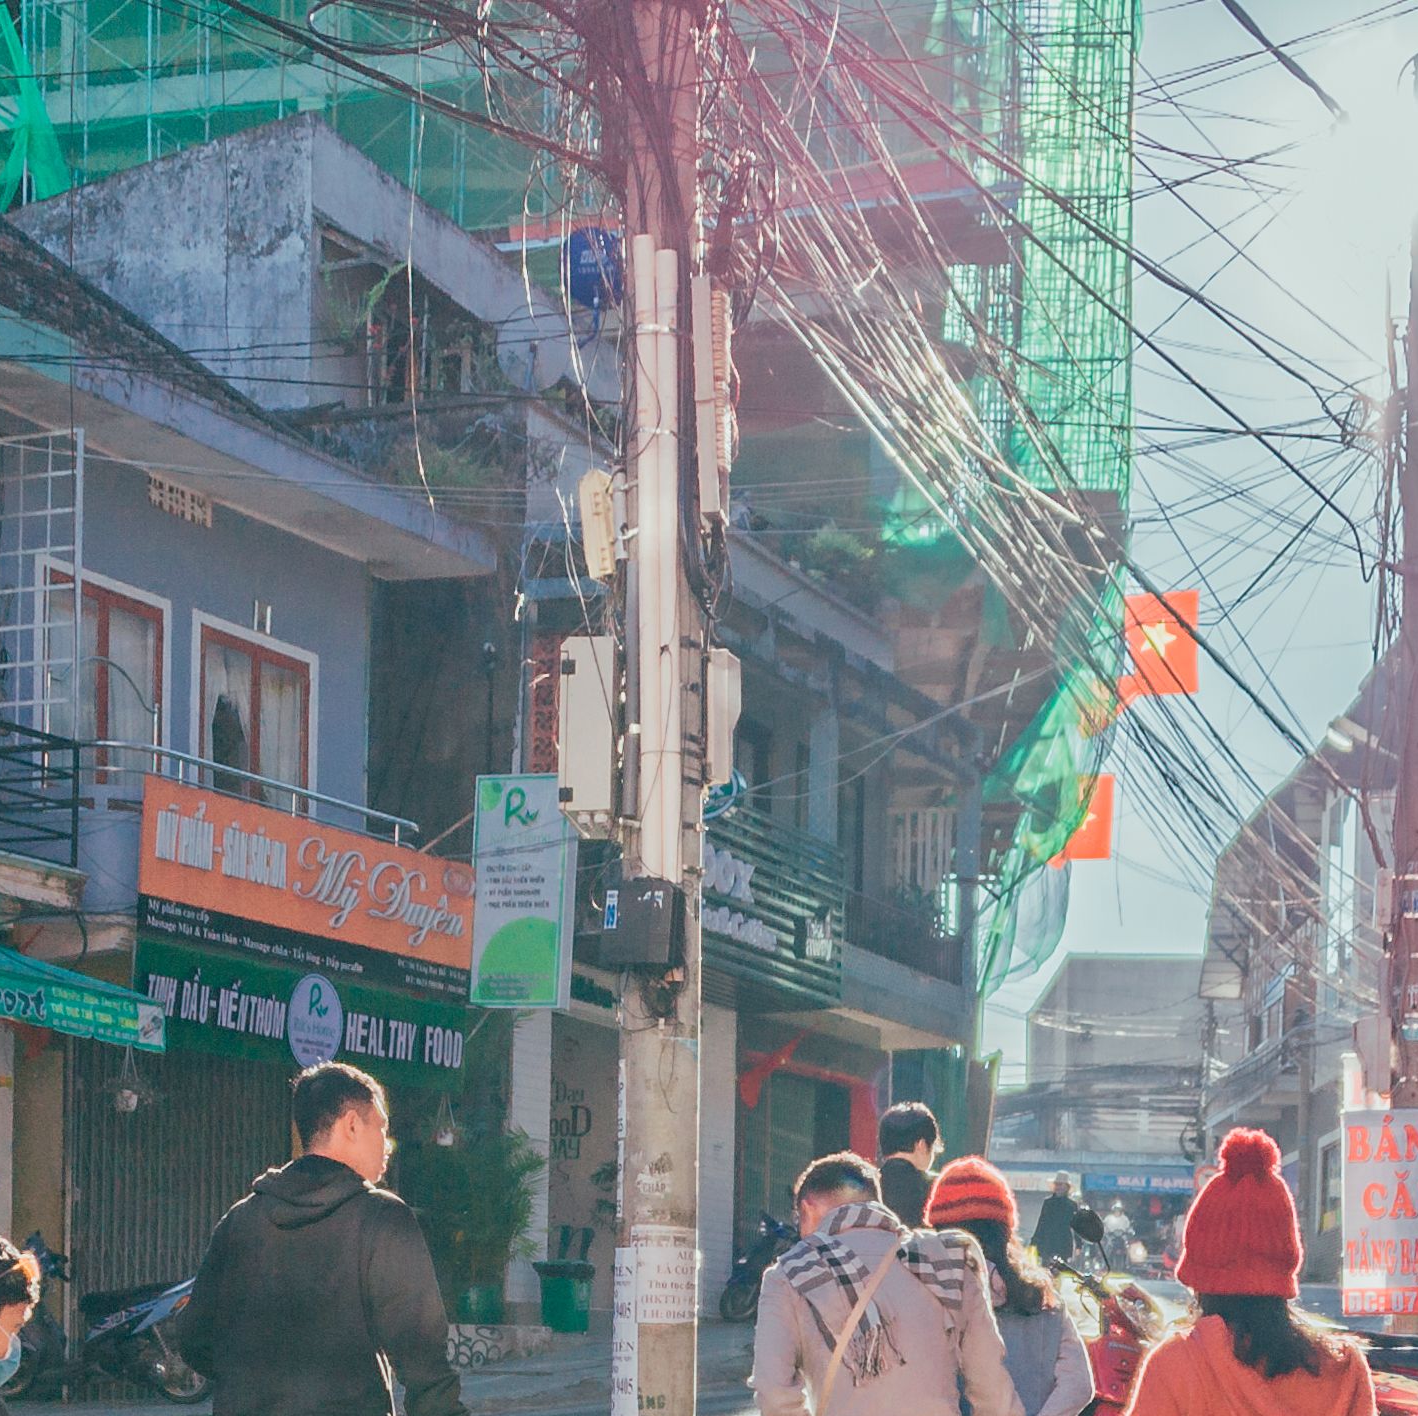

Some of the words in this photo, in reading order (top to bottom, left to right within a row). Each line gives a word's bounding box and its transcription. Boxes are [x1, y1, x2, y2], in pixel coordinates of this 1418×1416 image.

[345, 1011, 418, 1062] HEALTHY
[425, 1024, 464, 1069] FOOD
[1346, 1230, 1396, 1276] TĂNG
[1390, 1290, 1418, 1314] 07
